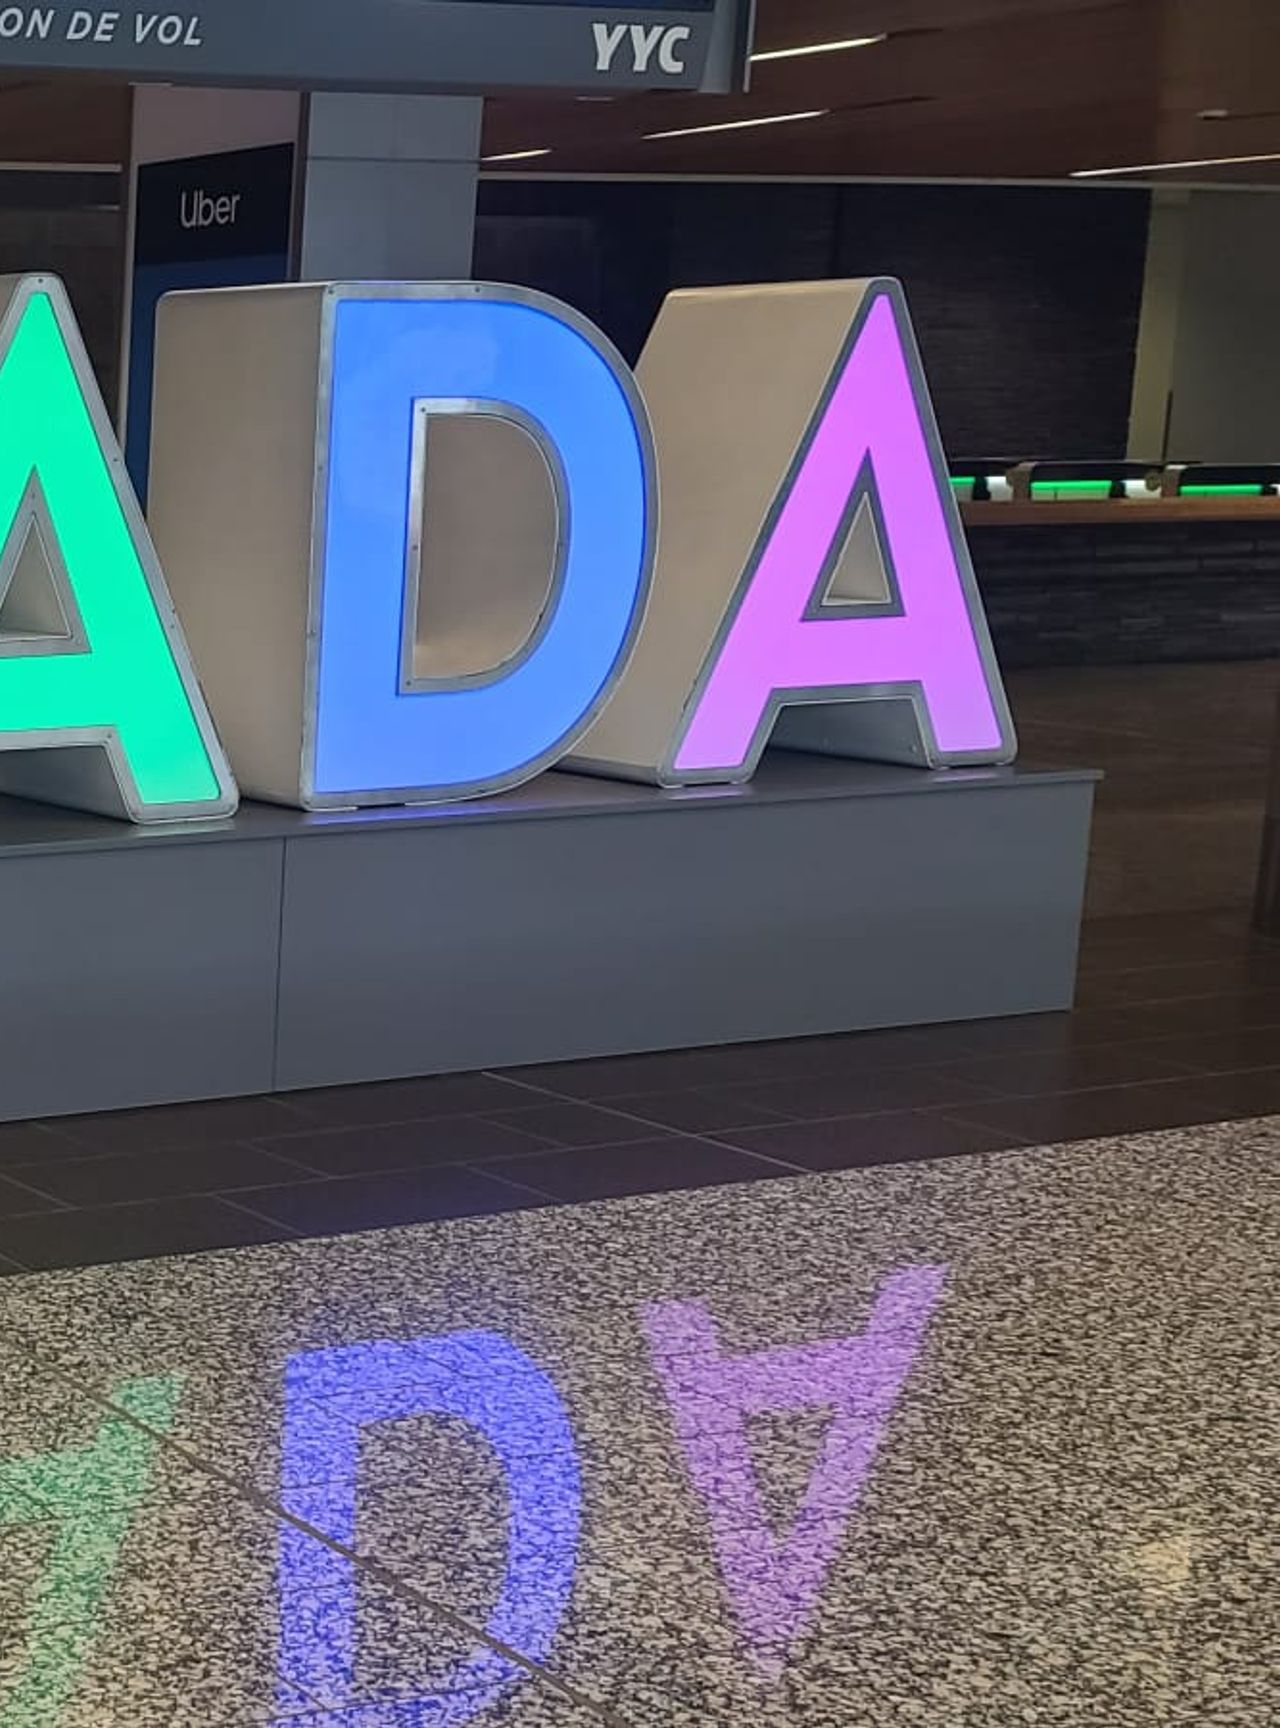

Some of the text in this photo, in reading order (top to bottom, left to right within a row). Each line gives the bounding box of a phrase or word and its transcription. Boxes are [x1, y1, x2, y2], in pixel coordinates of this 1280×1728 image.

[66, 11, 120, 42] DE
[135, 13, 202, 46] VOL
[592, 23, 690, 73] YYC
[180, 190, 240, 228] Uber
